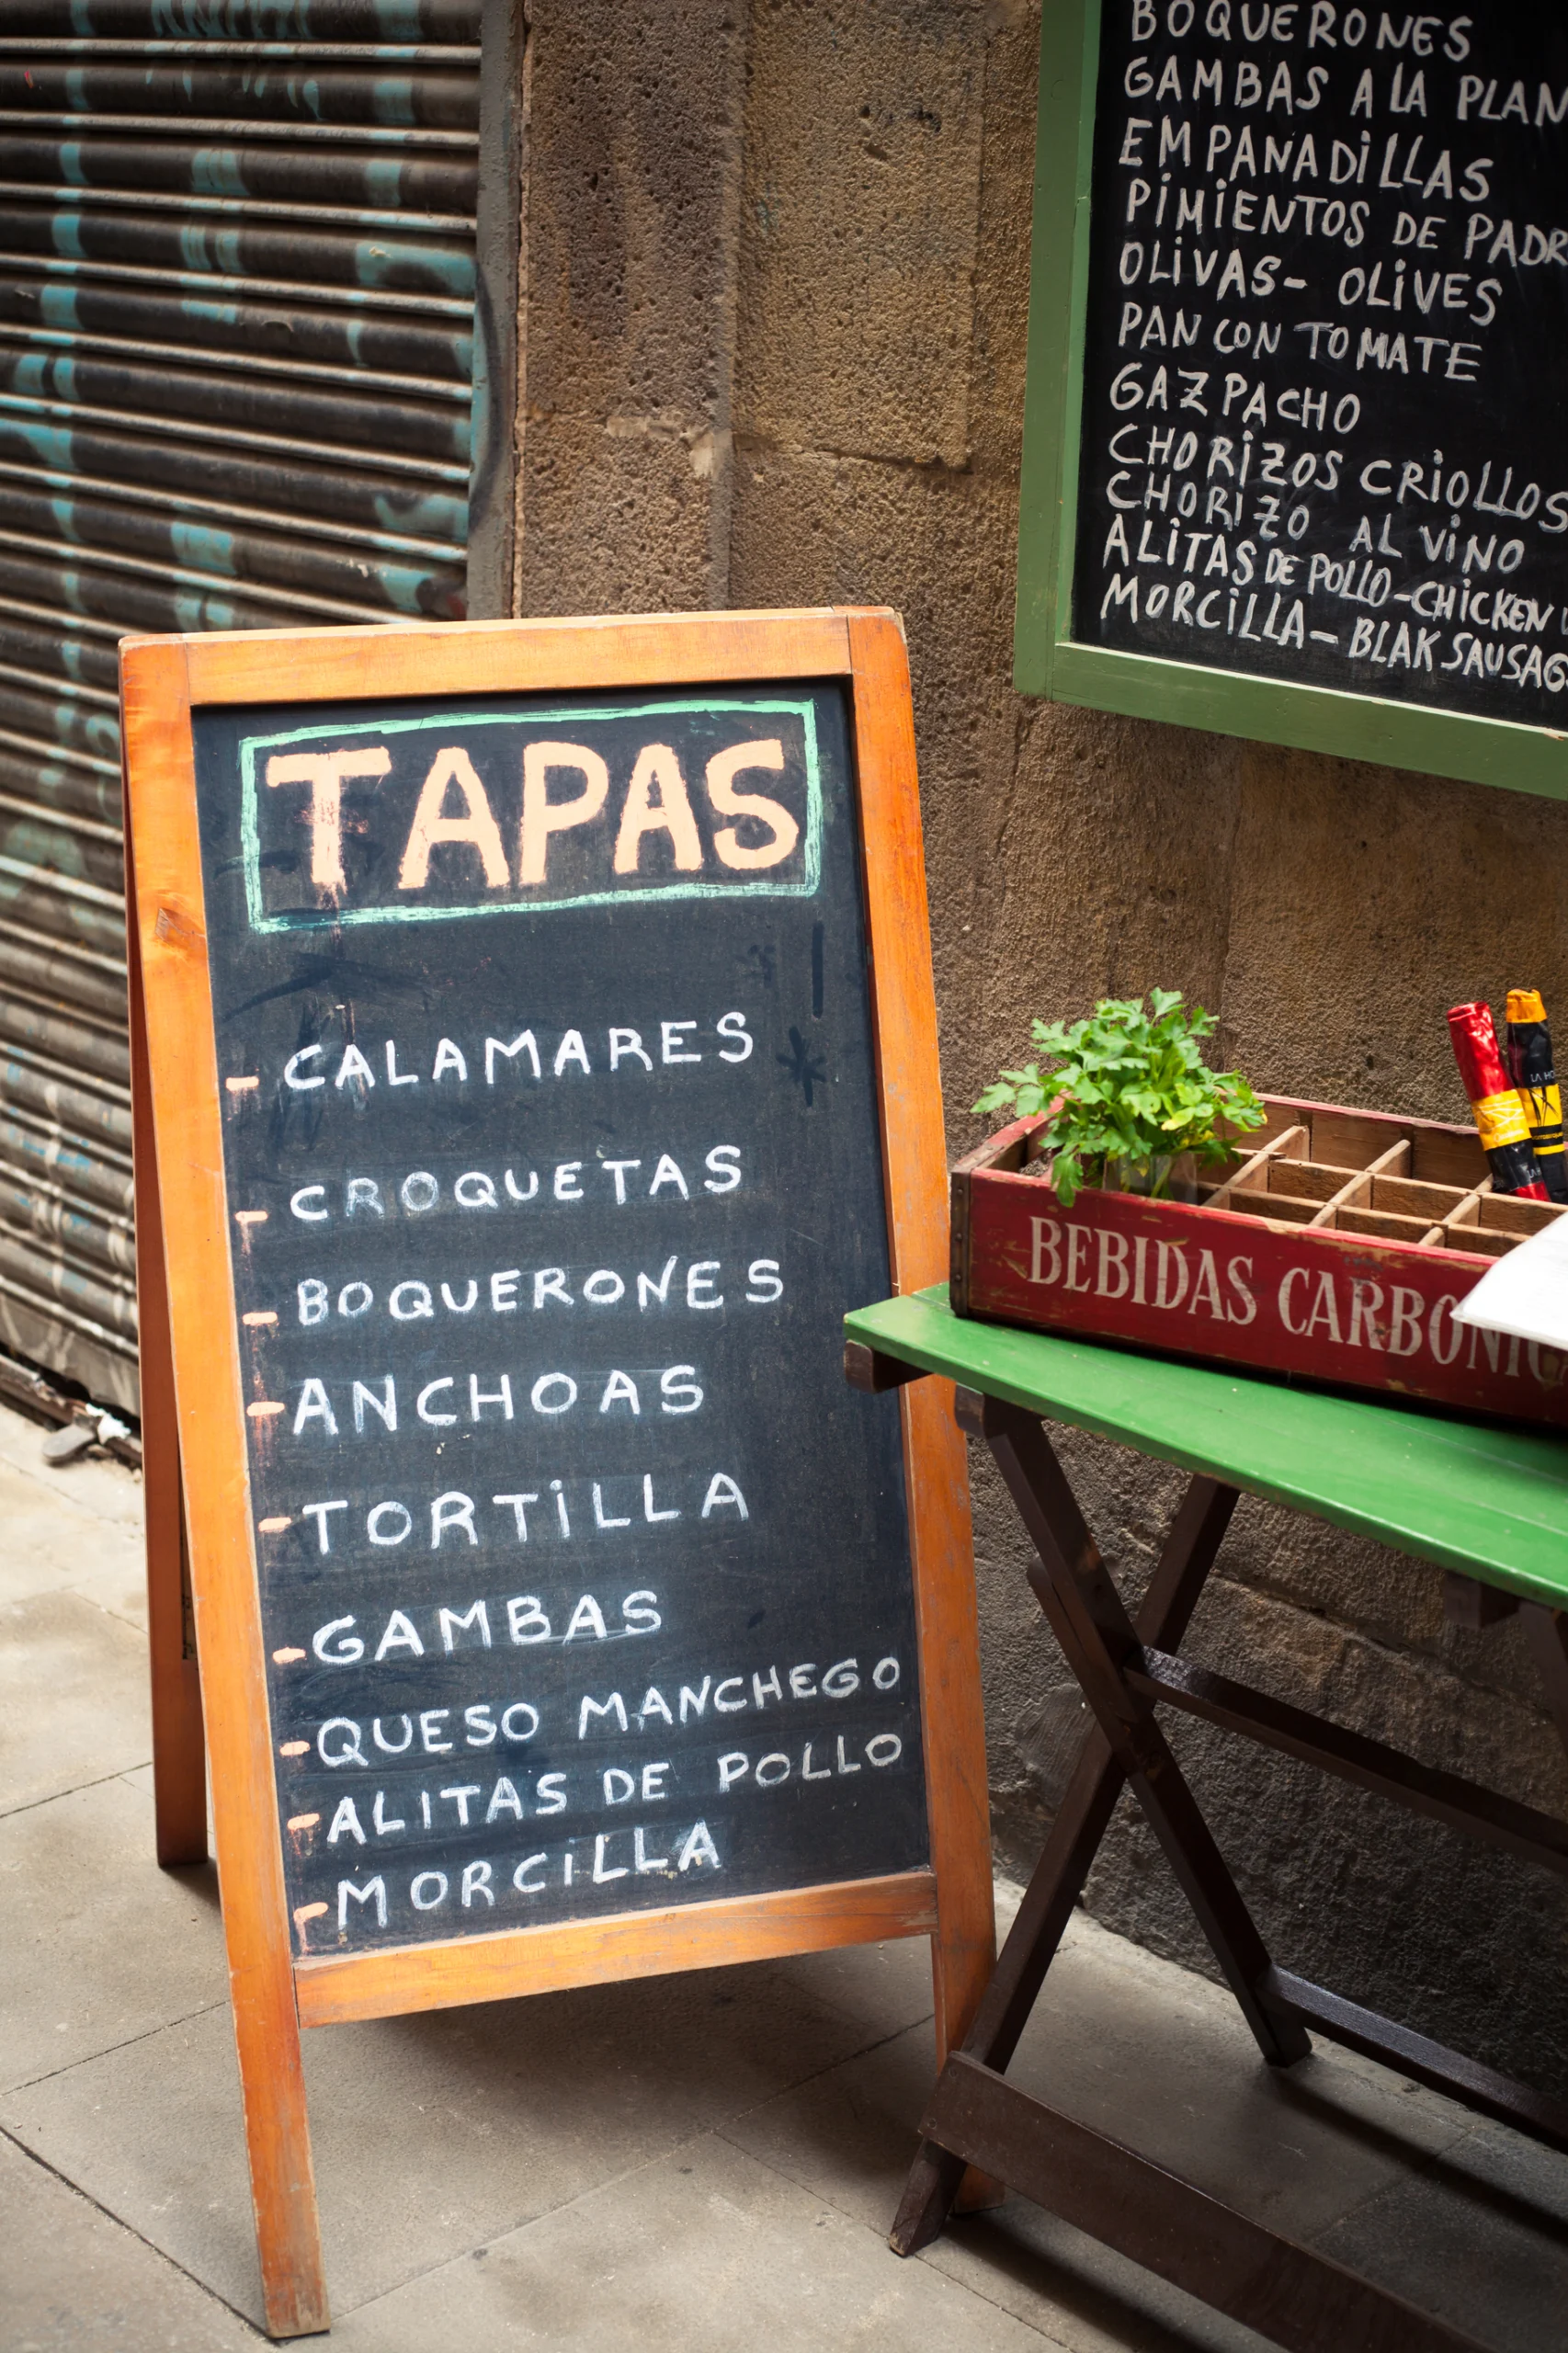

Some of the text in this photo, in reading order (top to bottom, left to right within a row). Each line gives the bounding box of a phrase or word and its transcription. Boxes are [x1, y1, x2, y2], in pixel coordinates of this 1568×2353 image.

[1131, 0, 1472, 62] BOQUERONES
[1124, 55, 1568, 127] GAMBAS A LA PLAN
[1392, 210, 1447, 249] DE
[1464, 212, 1568, 267] PADR
[1118, 301, 1483, 382] PAN CON TOMATE
[1109, 362, 1361, 434] GAZPACHO
[1106, 470, 1310, 540] CHORIZO
[1348, 513, 1403, 558] AL
[1265, 548, 1300, 585] DE
[1348, 616, 1441, 673] BLAK
[1440, 631, 1568, 692] SAUSAG
[264, 738, 800, 892] TAPAS
[283, 1011, 754, 1092] CALAMARES
[290, 1144, 743, 1222] CROQUETAS
[296, 1255, 784, 1326] BOQUERONES
[1028, 1215, 1257, 1325] BEBIDAS
[292, 1365, 705, 1437] ANCHOAS
[311, 1590, 662, 1665] GAMBAS
[315, 1656, 901, 1768] QUESO MANCHEGO
[326, 1733, 903, 1845] ALITAS DE POLLO
